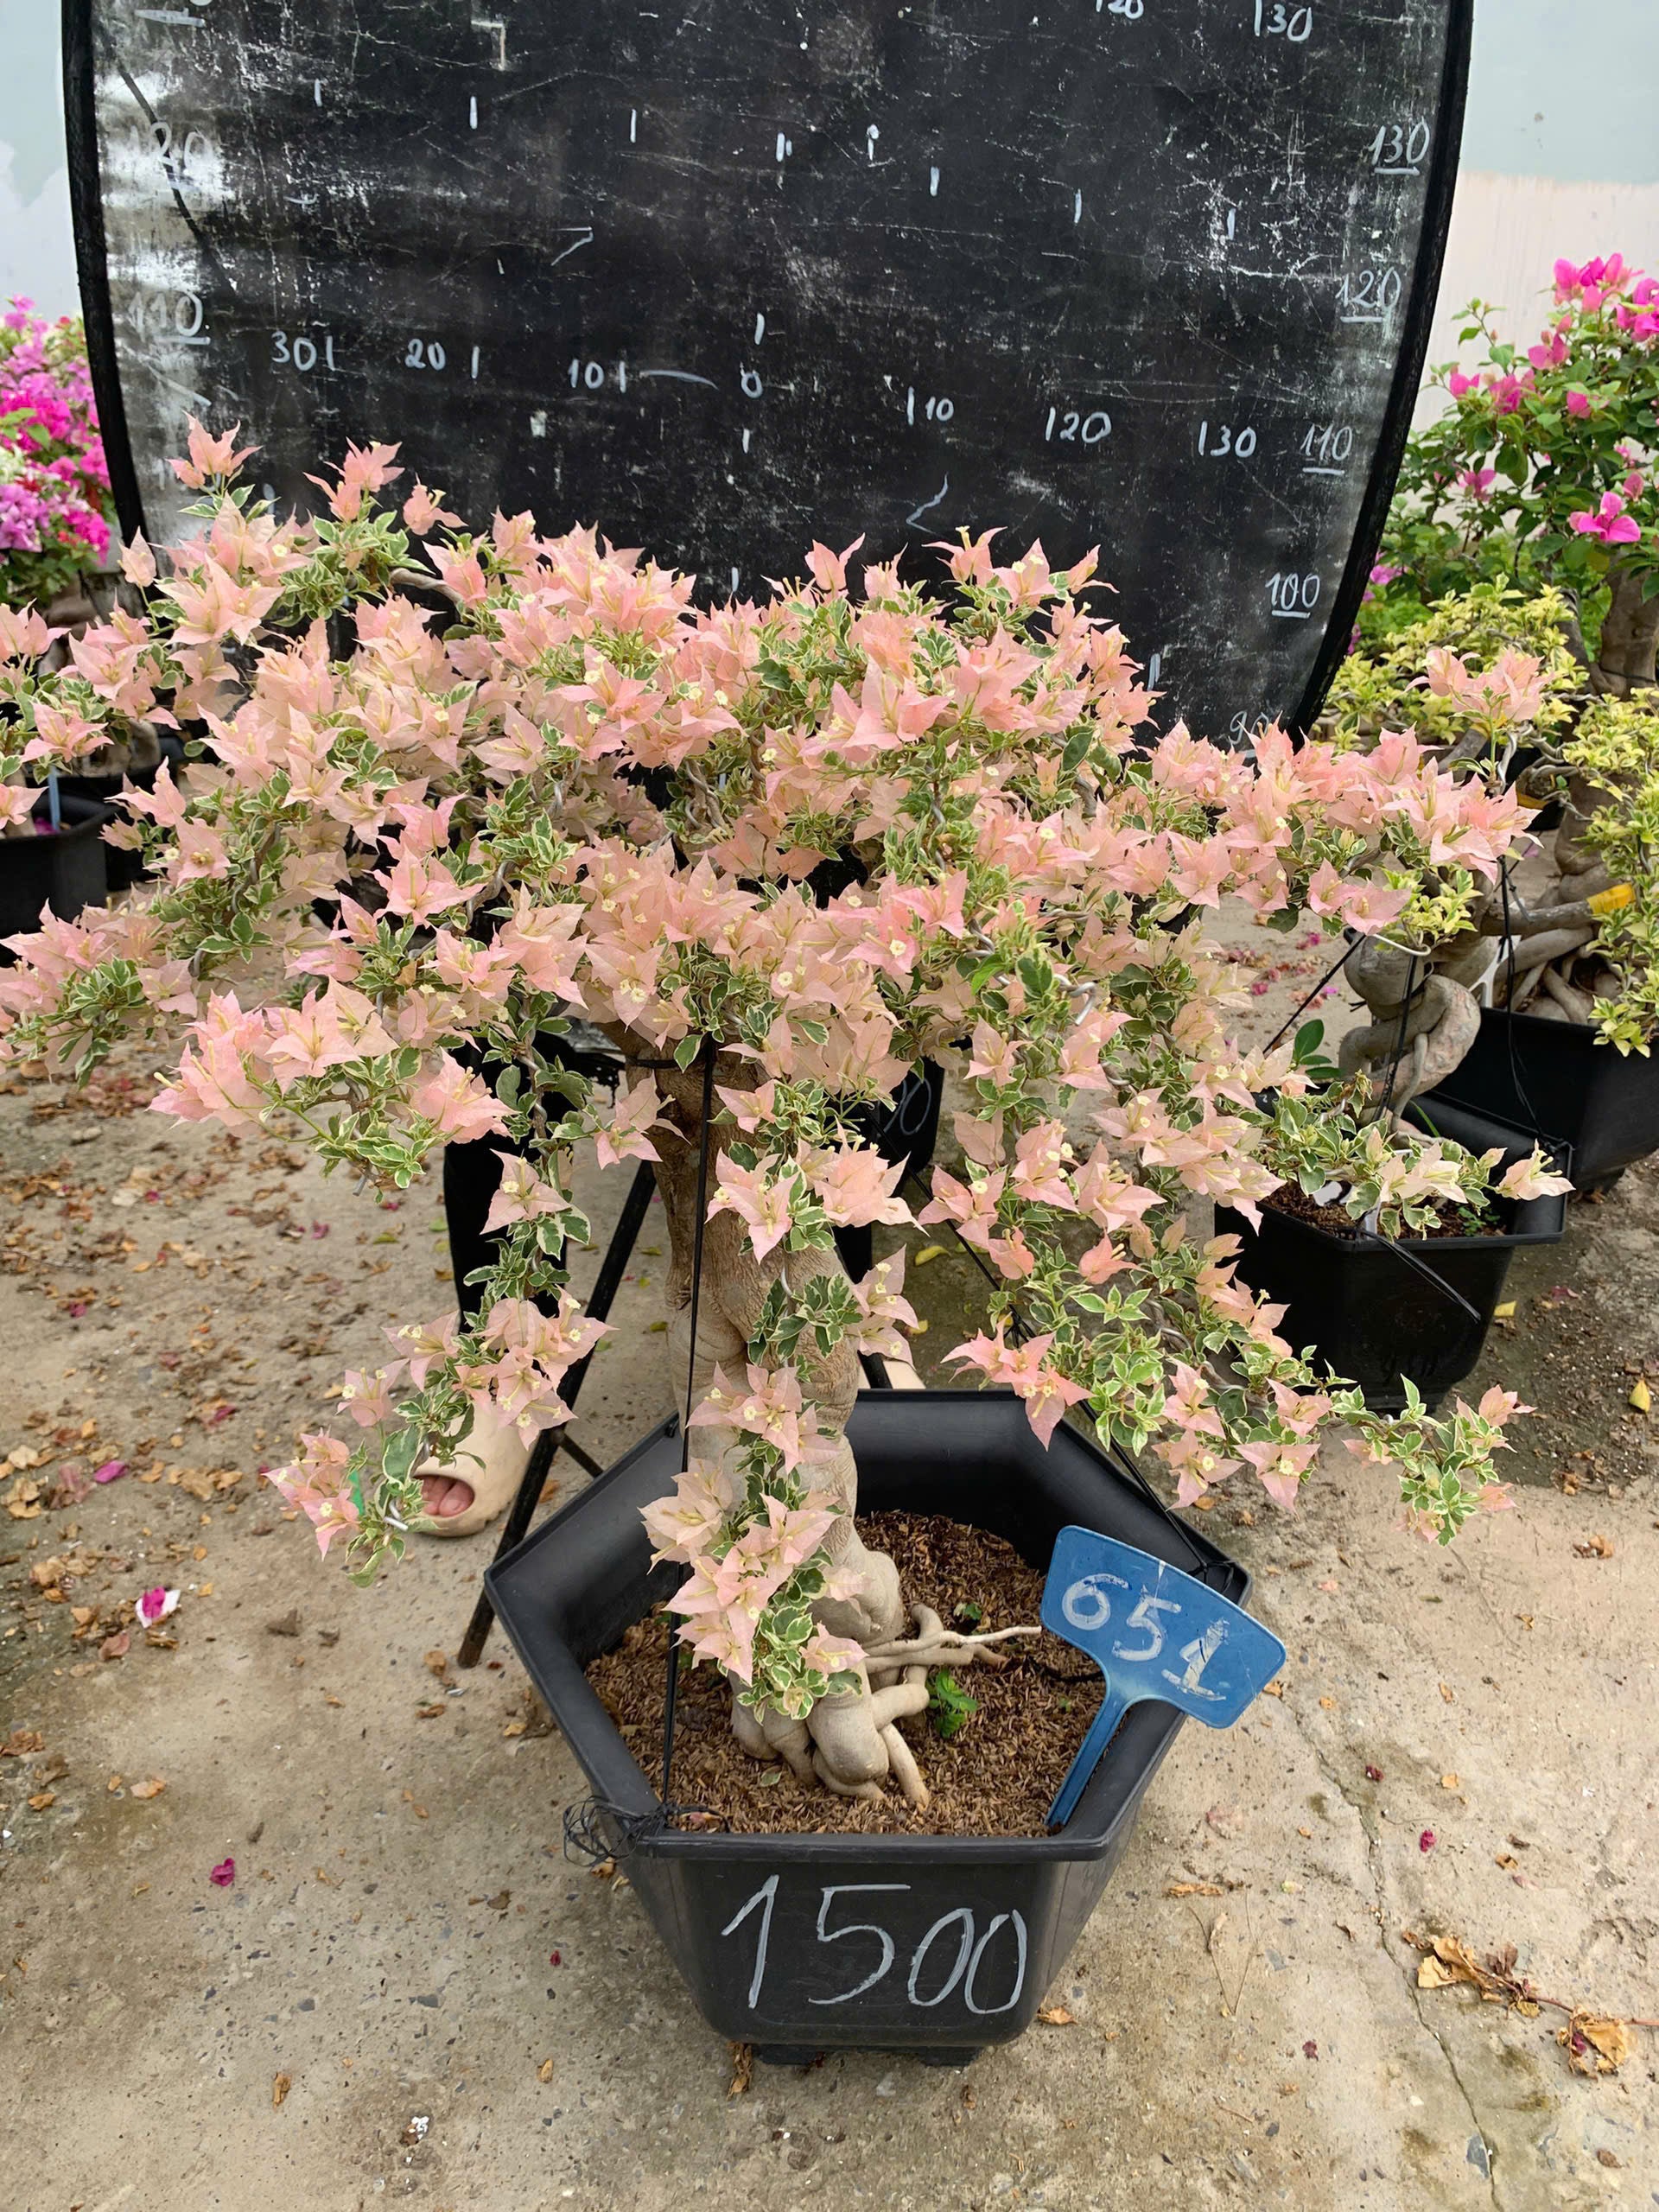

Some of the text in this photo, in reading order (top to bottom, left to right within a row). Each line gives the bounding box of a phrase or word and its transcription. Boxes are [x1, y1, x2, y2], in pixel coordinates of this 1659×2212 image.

[1368, 116, 1430, 166] 130
[1335, 267, 1402, 309] 120
[1299, 423, 1353, 461] 110
[1264, 572, 1320, 611] 100
[721, 1873, 1028, 2014] 1500
